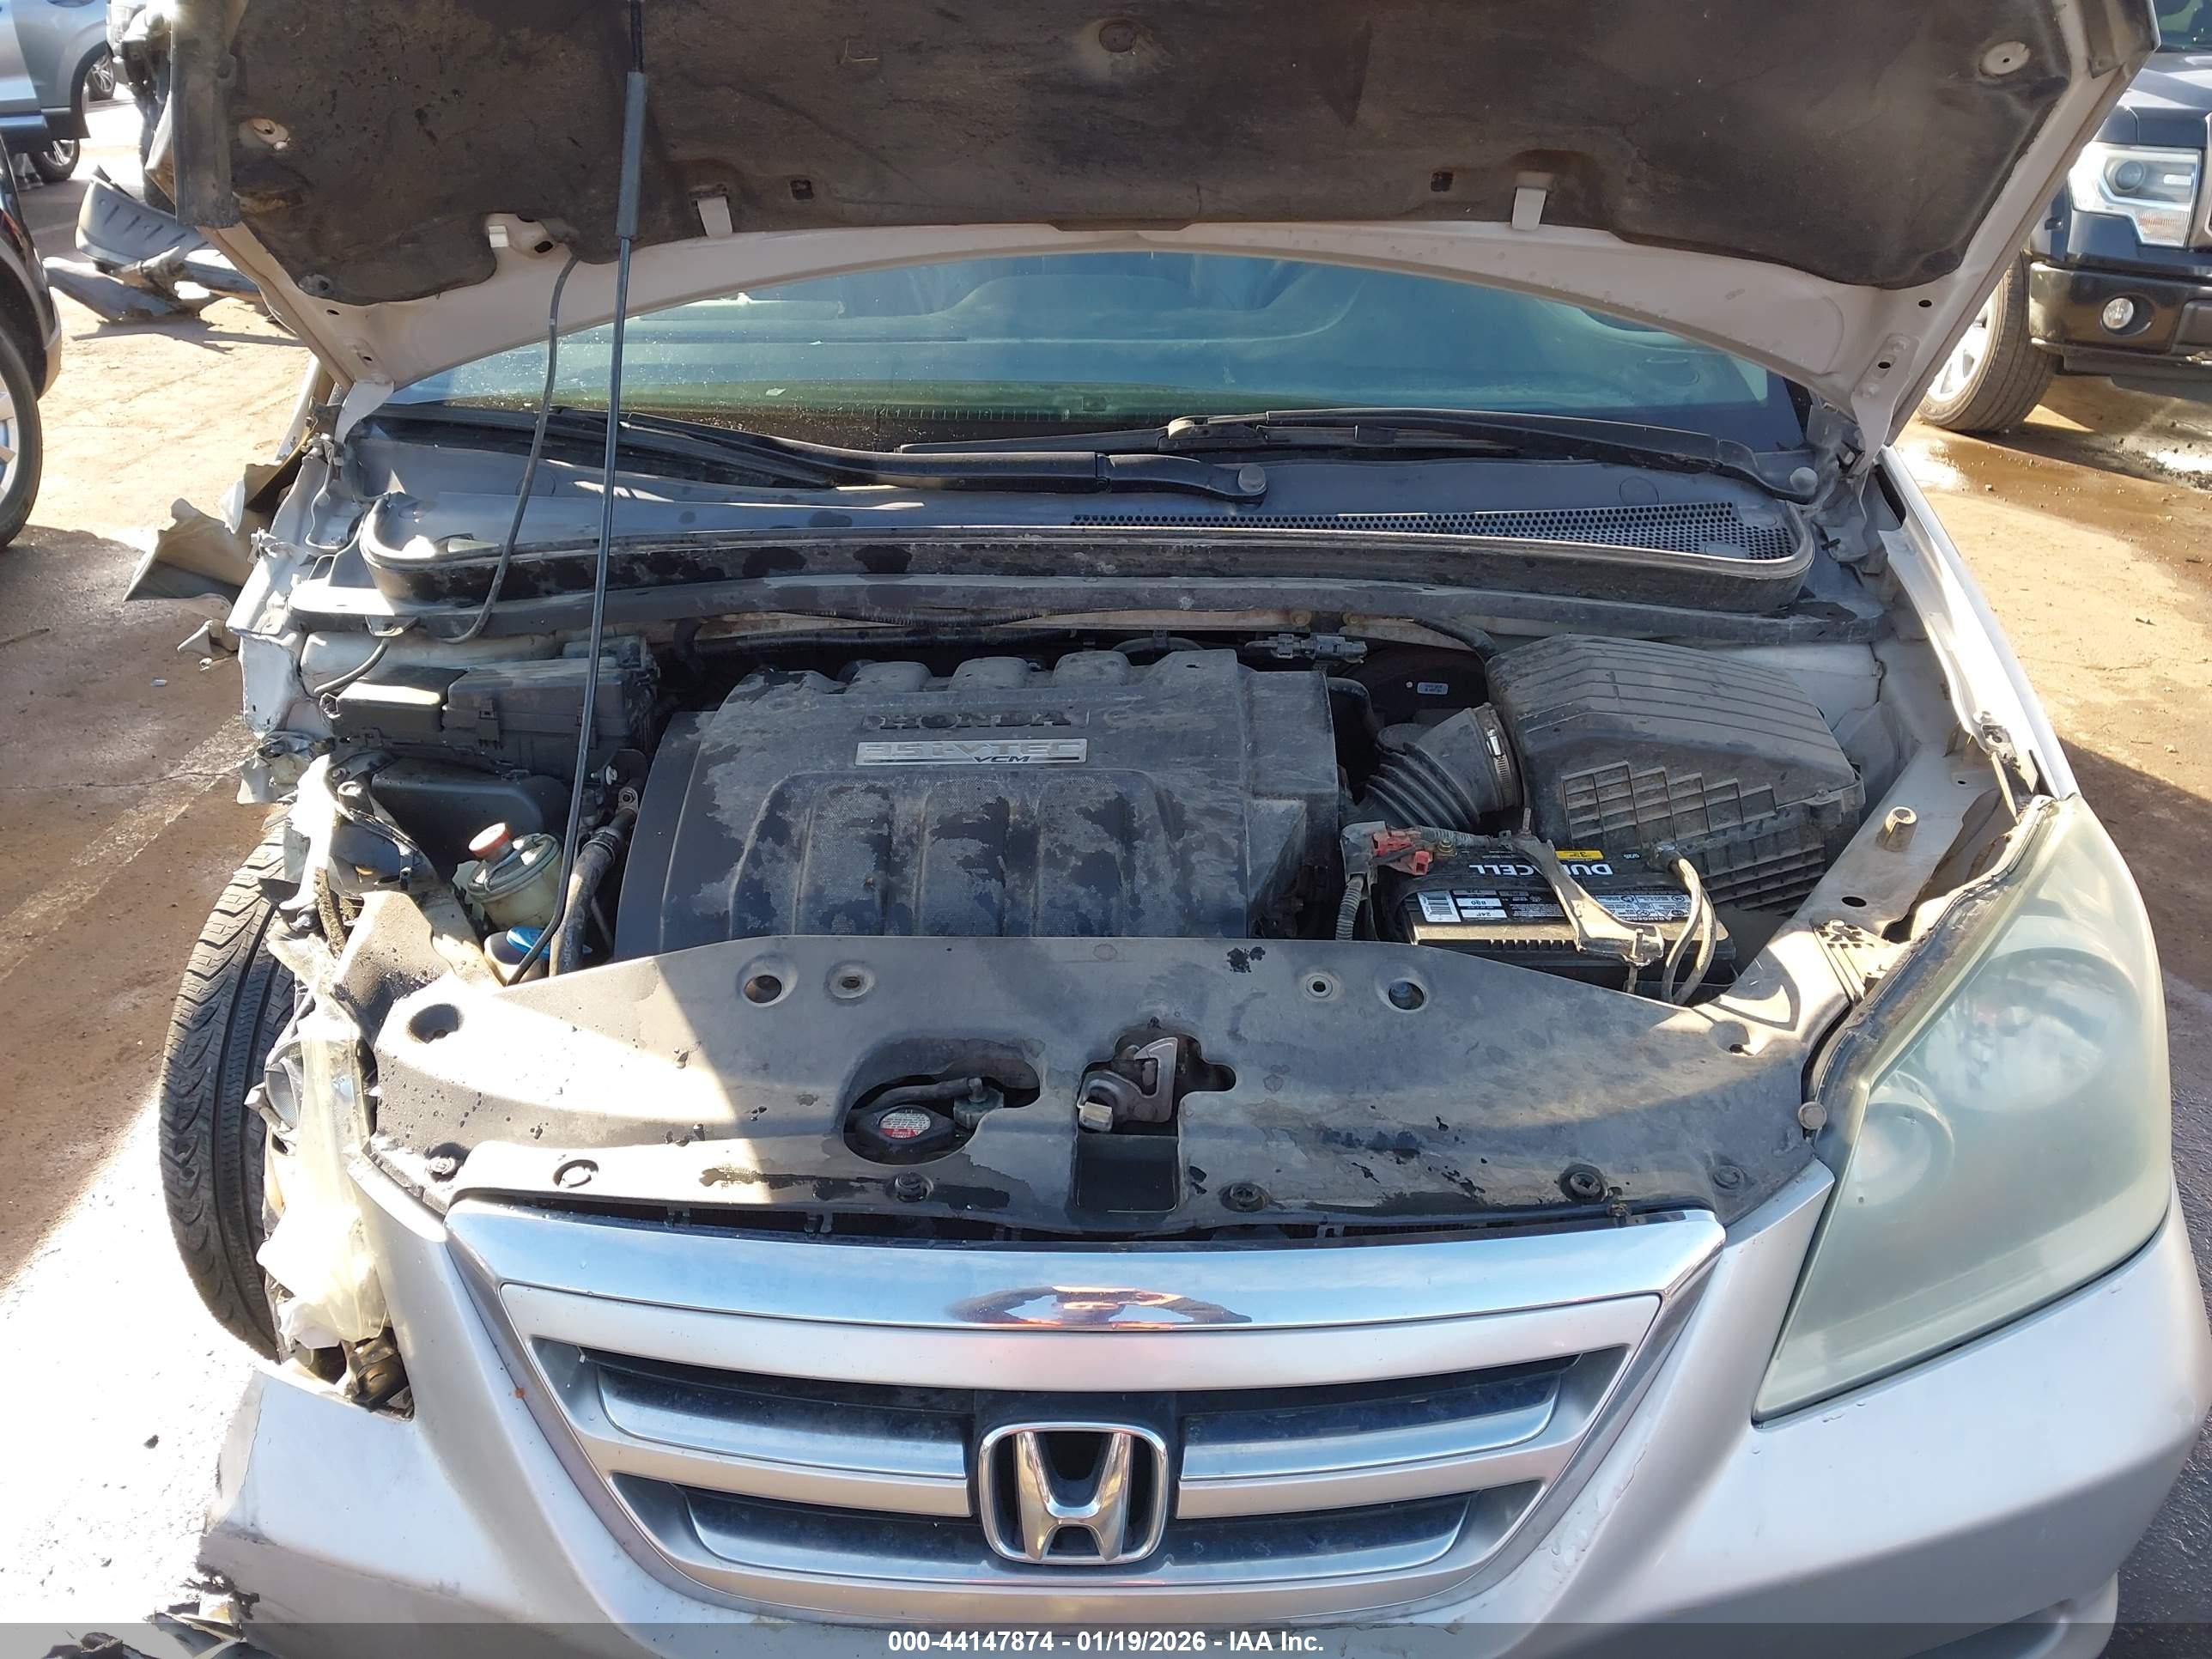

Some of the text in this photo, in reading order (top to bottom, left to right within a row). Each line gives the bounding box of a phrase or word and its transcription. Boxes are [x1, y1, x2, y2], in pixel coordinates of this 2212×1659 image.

[878, 709, 1072, 730] HONDA
[933, 743, 1081, 757] i-VTEC
[1468, 863, 1613, 876] DUCELL
